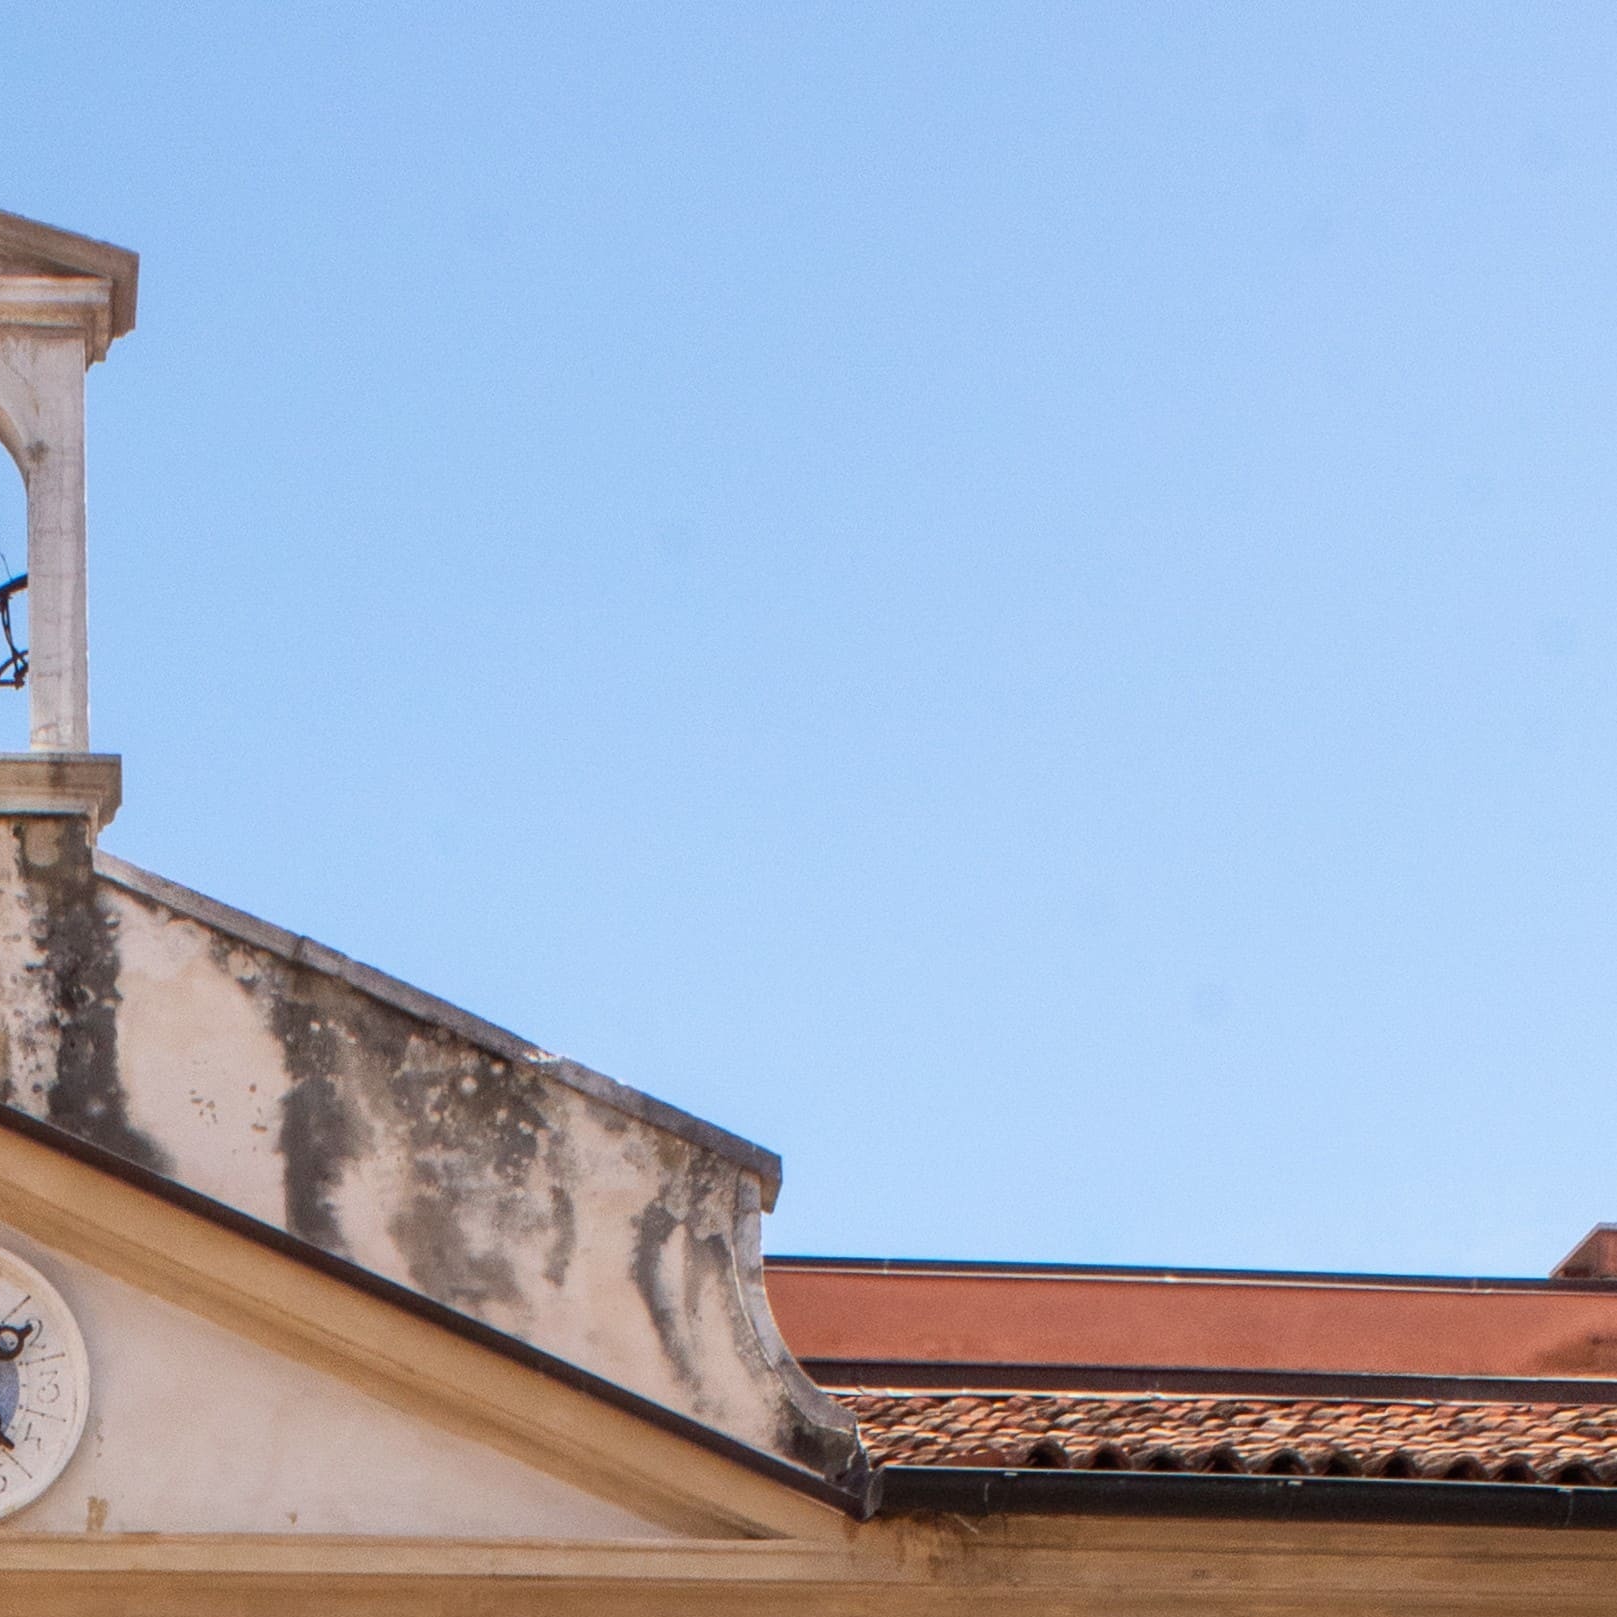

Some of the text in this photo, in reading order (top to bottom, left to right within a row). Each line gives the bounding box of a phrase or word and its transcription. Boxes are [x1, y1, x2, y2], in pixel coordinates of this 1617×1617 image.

[26, 1319, 47, 1350] 2
[37, 1371, 61, 1404] 3
[23, 1422, 43, 1451] 4
